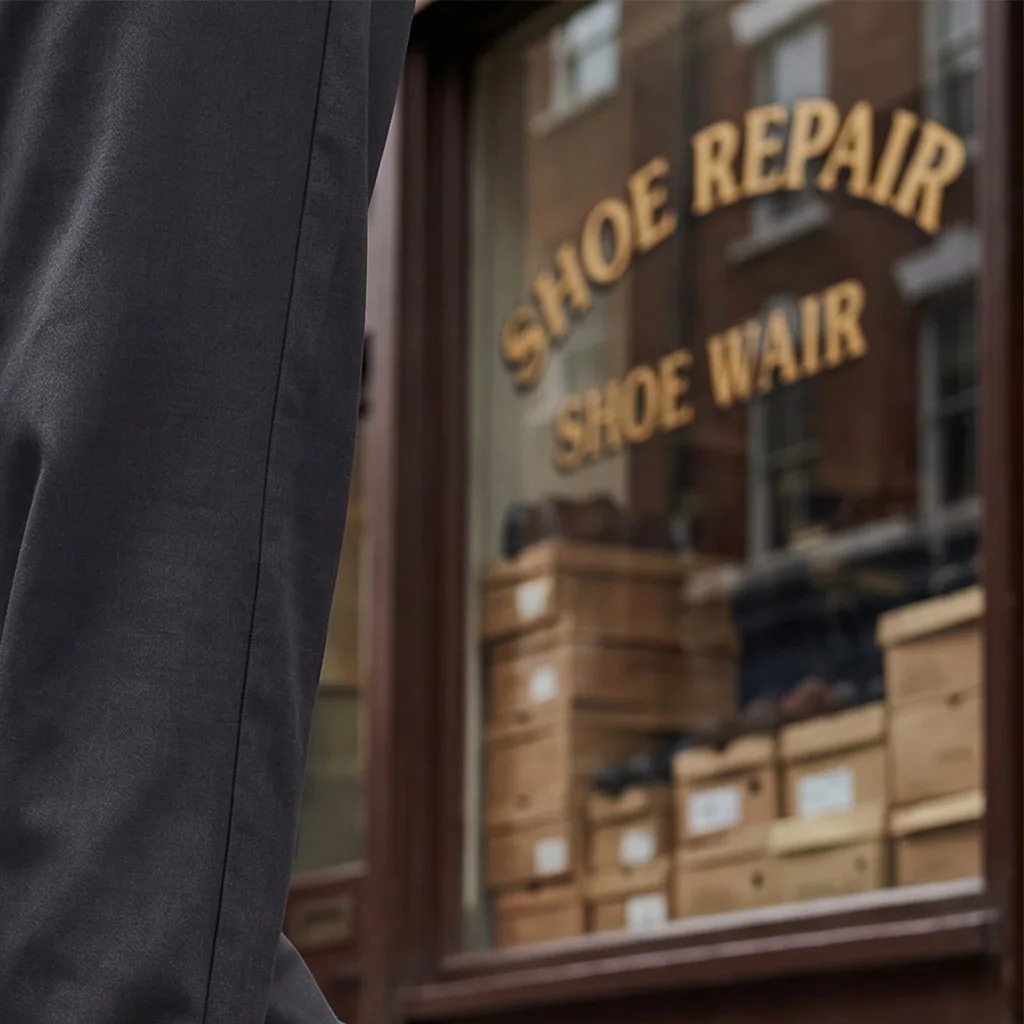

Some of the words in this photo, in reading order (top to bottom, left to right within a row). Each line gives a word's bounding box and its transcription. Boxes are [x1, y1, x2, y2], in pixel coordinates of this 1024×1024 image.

[502, 157, 676, 390] SHOE
[691, 99, 966, 234] REPAIR
[554, 350, 695, 473] SHOE
[707, 280, 868, 407] WAIR
